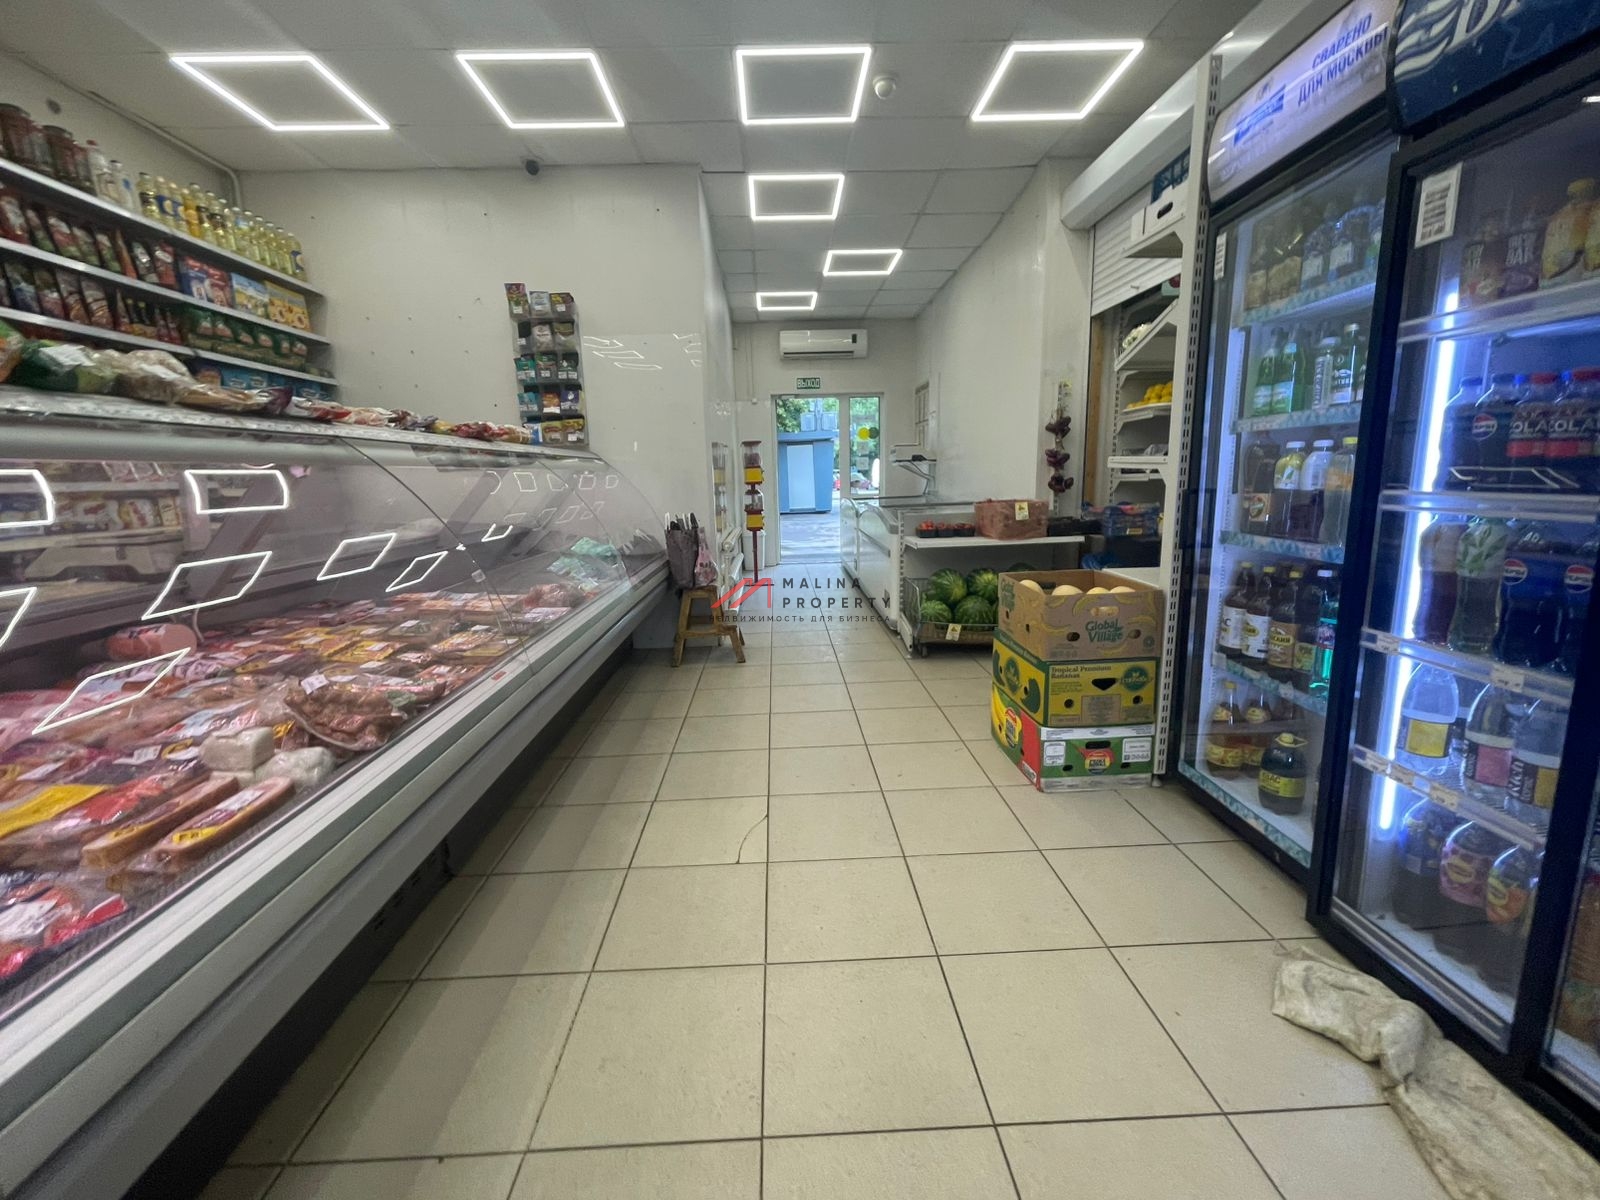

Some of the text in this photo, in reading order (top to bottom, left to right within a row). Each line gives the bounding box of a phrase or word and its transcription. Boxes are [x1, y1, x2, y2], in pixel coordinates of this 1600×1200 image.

[1312, 13, 1373, 69] СВАРЕНО
[1298, 26, 1388, 106] ДЛЯ МОСКВЫ
[797, 378, 820, 389] ВЫХОД
[1085, 618, 1119, 632] Global
[1088, 627, 1124, 643] Village
